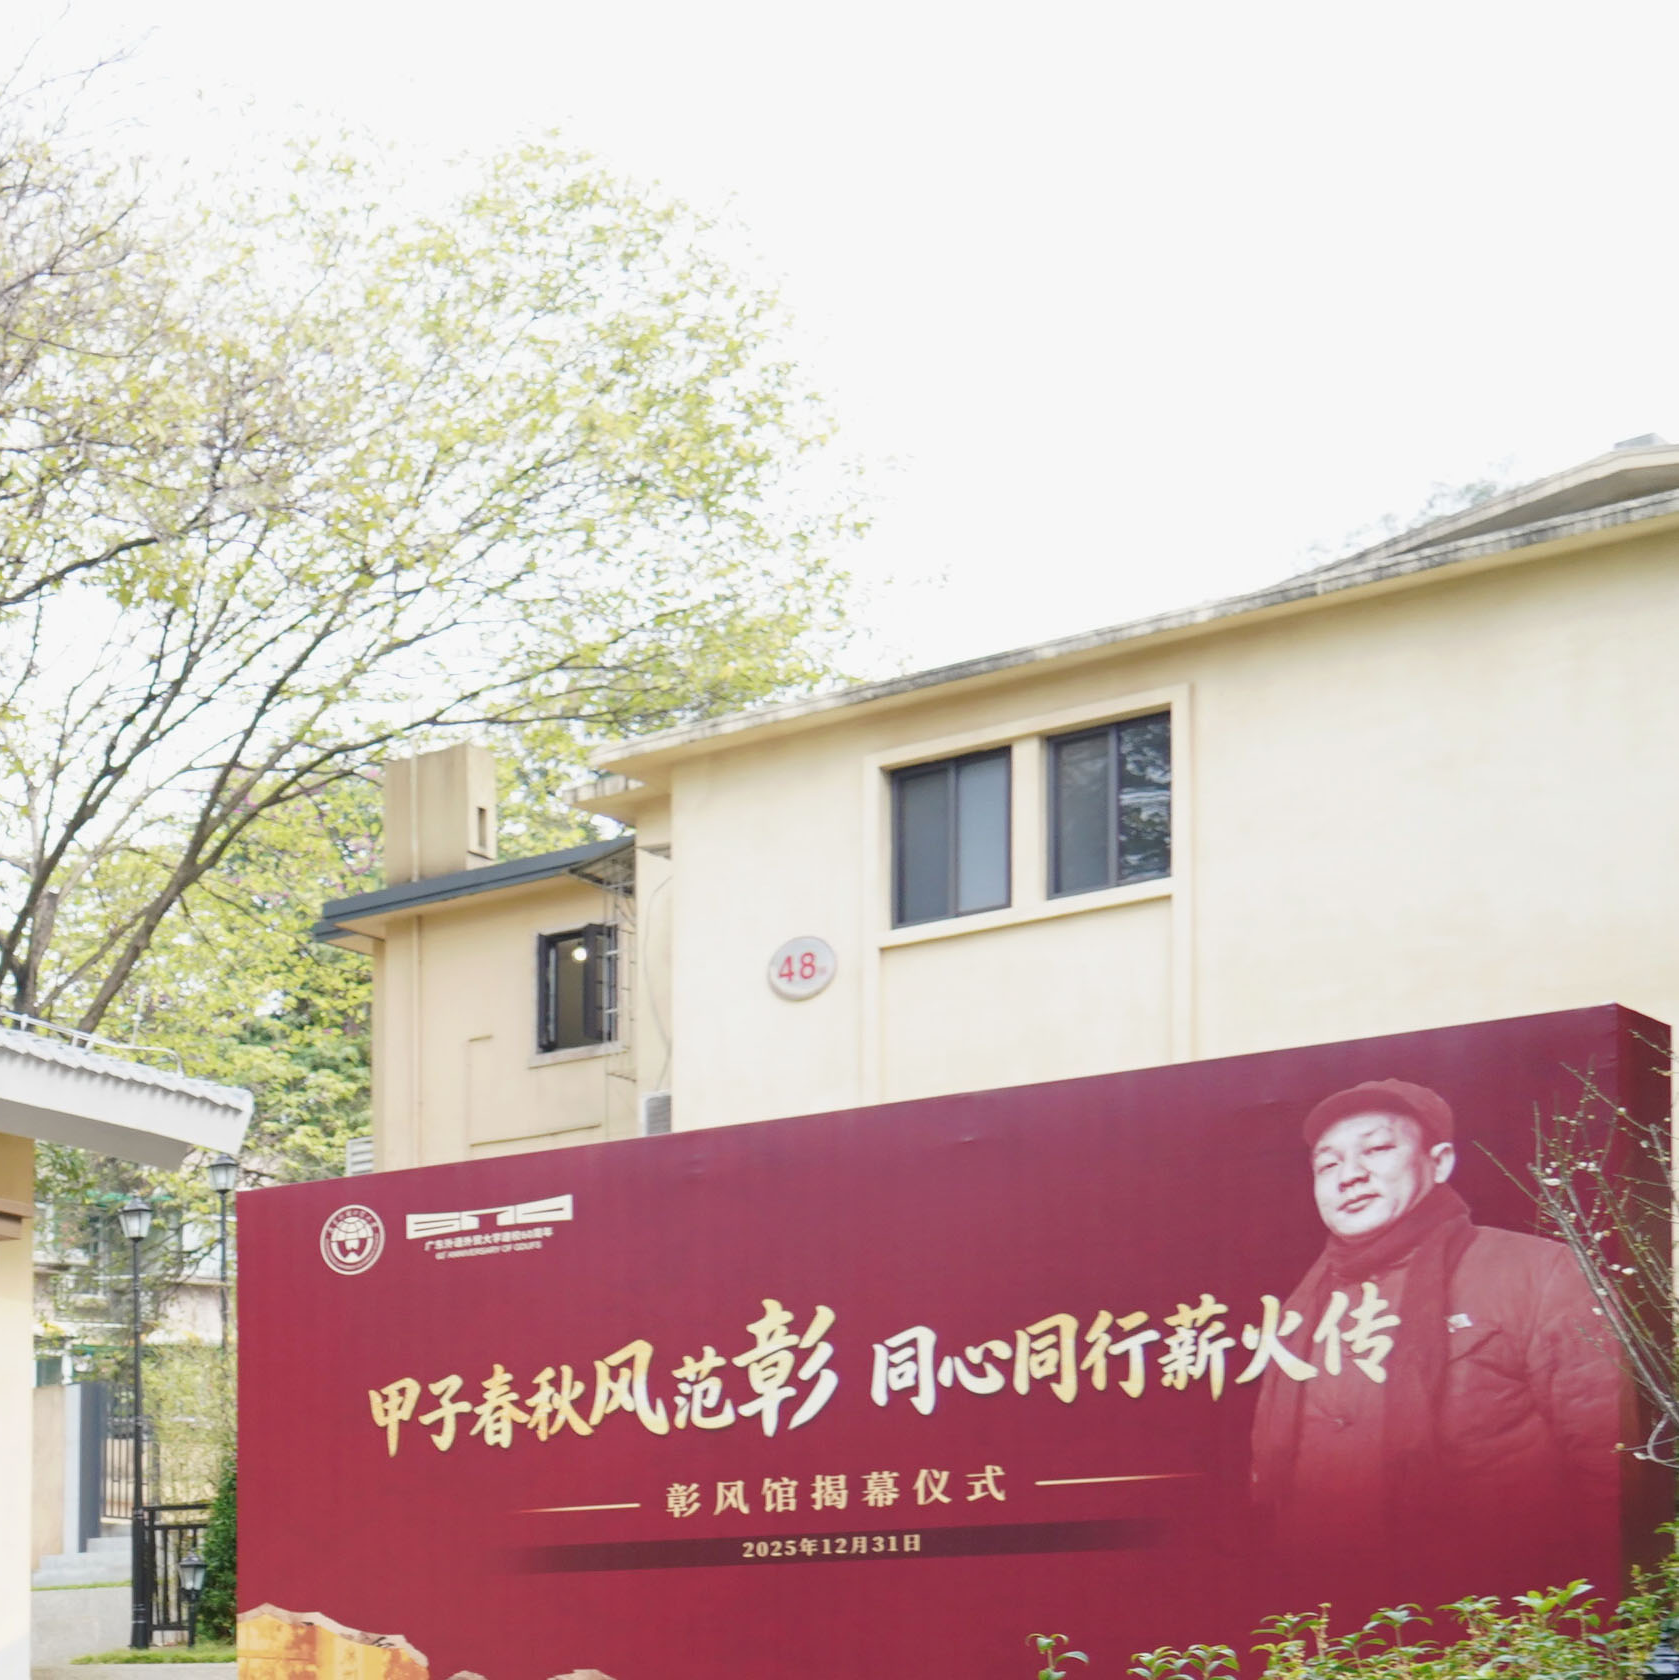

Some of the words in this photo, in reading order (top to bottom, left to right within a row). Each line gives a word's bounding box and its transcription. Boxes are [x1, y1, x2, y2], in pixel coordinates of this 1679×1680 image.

[778, 952, 816, 982] 48
[368, 1298, 839, 1458] 甲子春秋风范彰
[870, 1281, 1401, 1416] 同心同行薪火传
[665, 1465, 1007, 1518] 彰风馆揭幕仪式
[742, 1534, 922, 1558] 2025年12月31日
